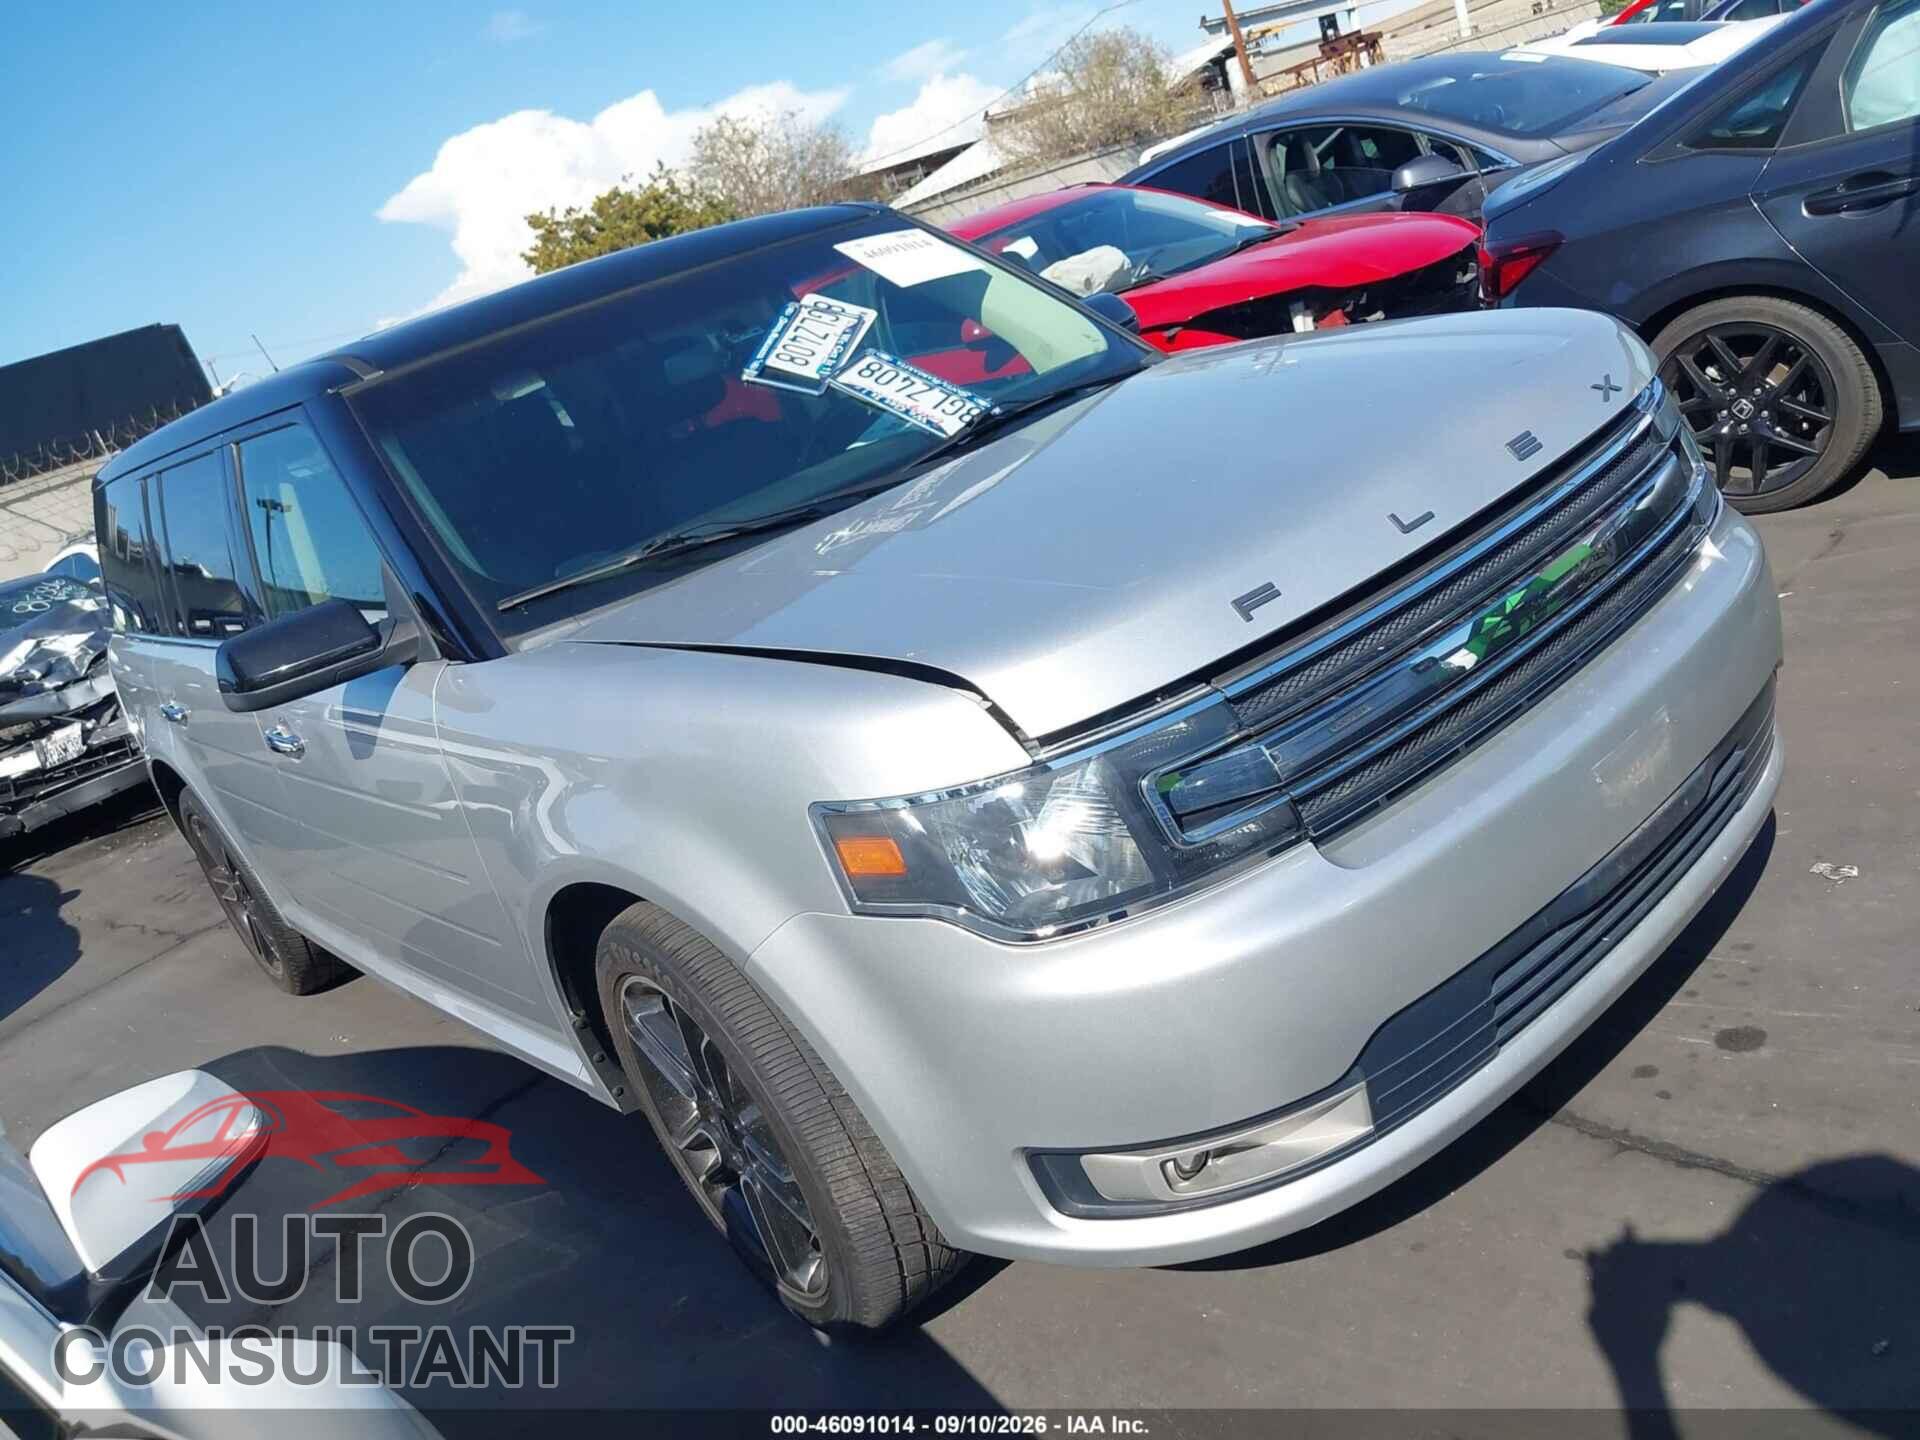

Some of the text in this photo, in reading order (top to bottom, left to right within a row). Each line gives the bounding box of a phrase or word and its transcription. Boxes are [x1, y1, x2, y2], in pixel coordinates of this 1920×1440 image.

[775, 301, 846, 367] 8GLZ408
[858, 361, 982, 423] 8GLZ408
[1231, 373, 1623, 622] FLEX
